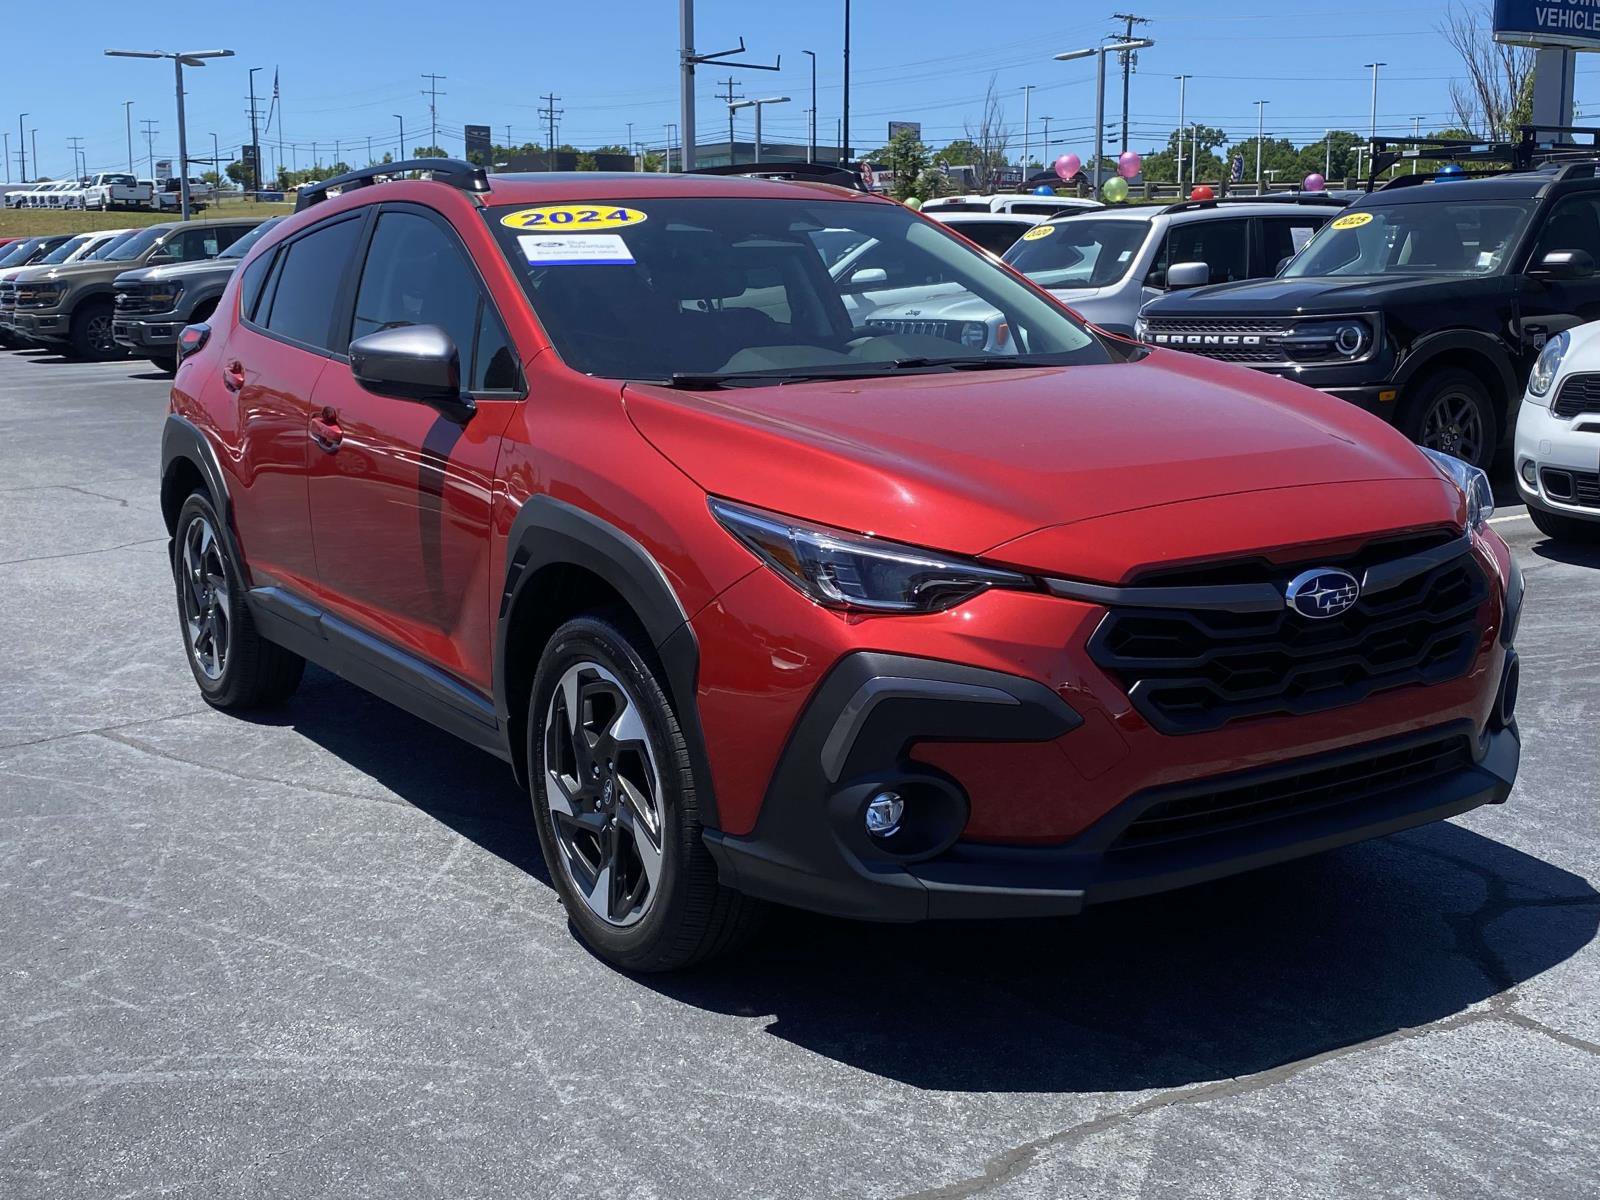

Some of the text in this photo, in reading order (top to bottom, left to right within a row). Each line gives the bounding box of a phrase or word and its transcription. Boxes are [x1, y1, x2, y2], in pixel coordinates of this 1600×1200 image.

[1535, 7, 1600, 31] VEHICLE
[521, 209, 631, 227] 2024
[1155, 334, 1260, 345] BRONCO
